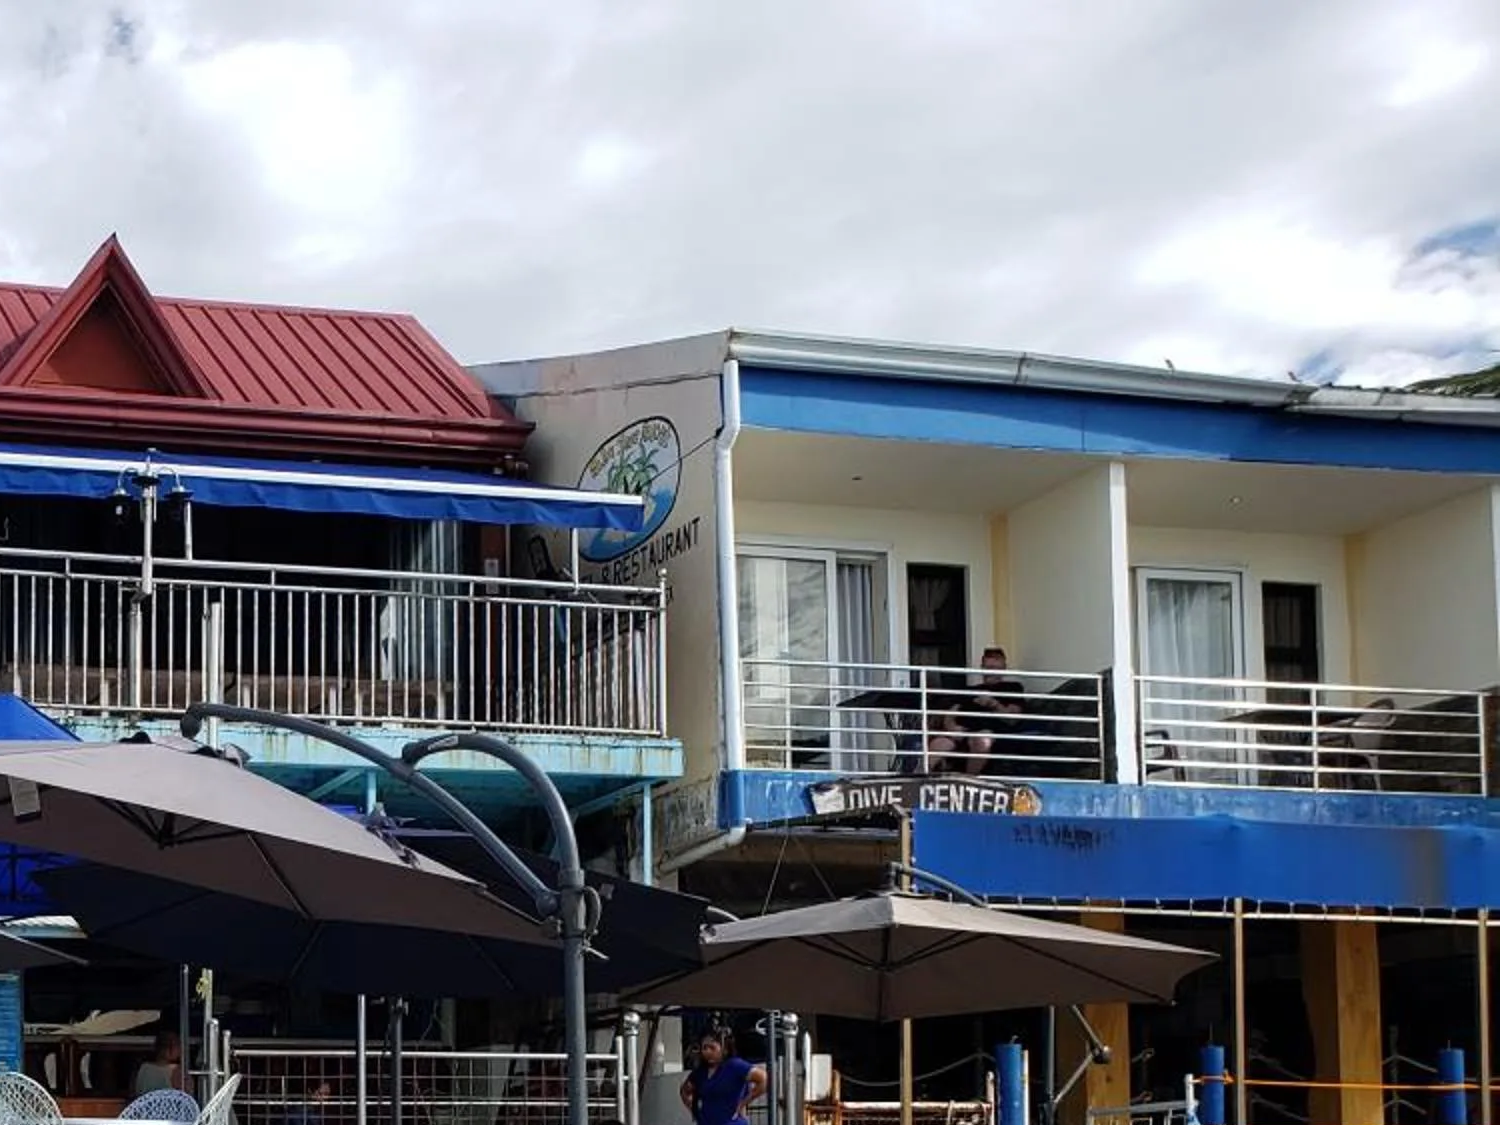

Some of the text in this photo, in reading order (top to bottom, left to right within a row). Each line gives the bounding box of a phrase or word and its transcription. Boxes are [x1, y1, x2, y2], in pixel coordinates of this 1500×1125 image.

[613, 516, 701, 585] RESTAURANT
[846, 784, 1008, 814] DIVE CENTER
